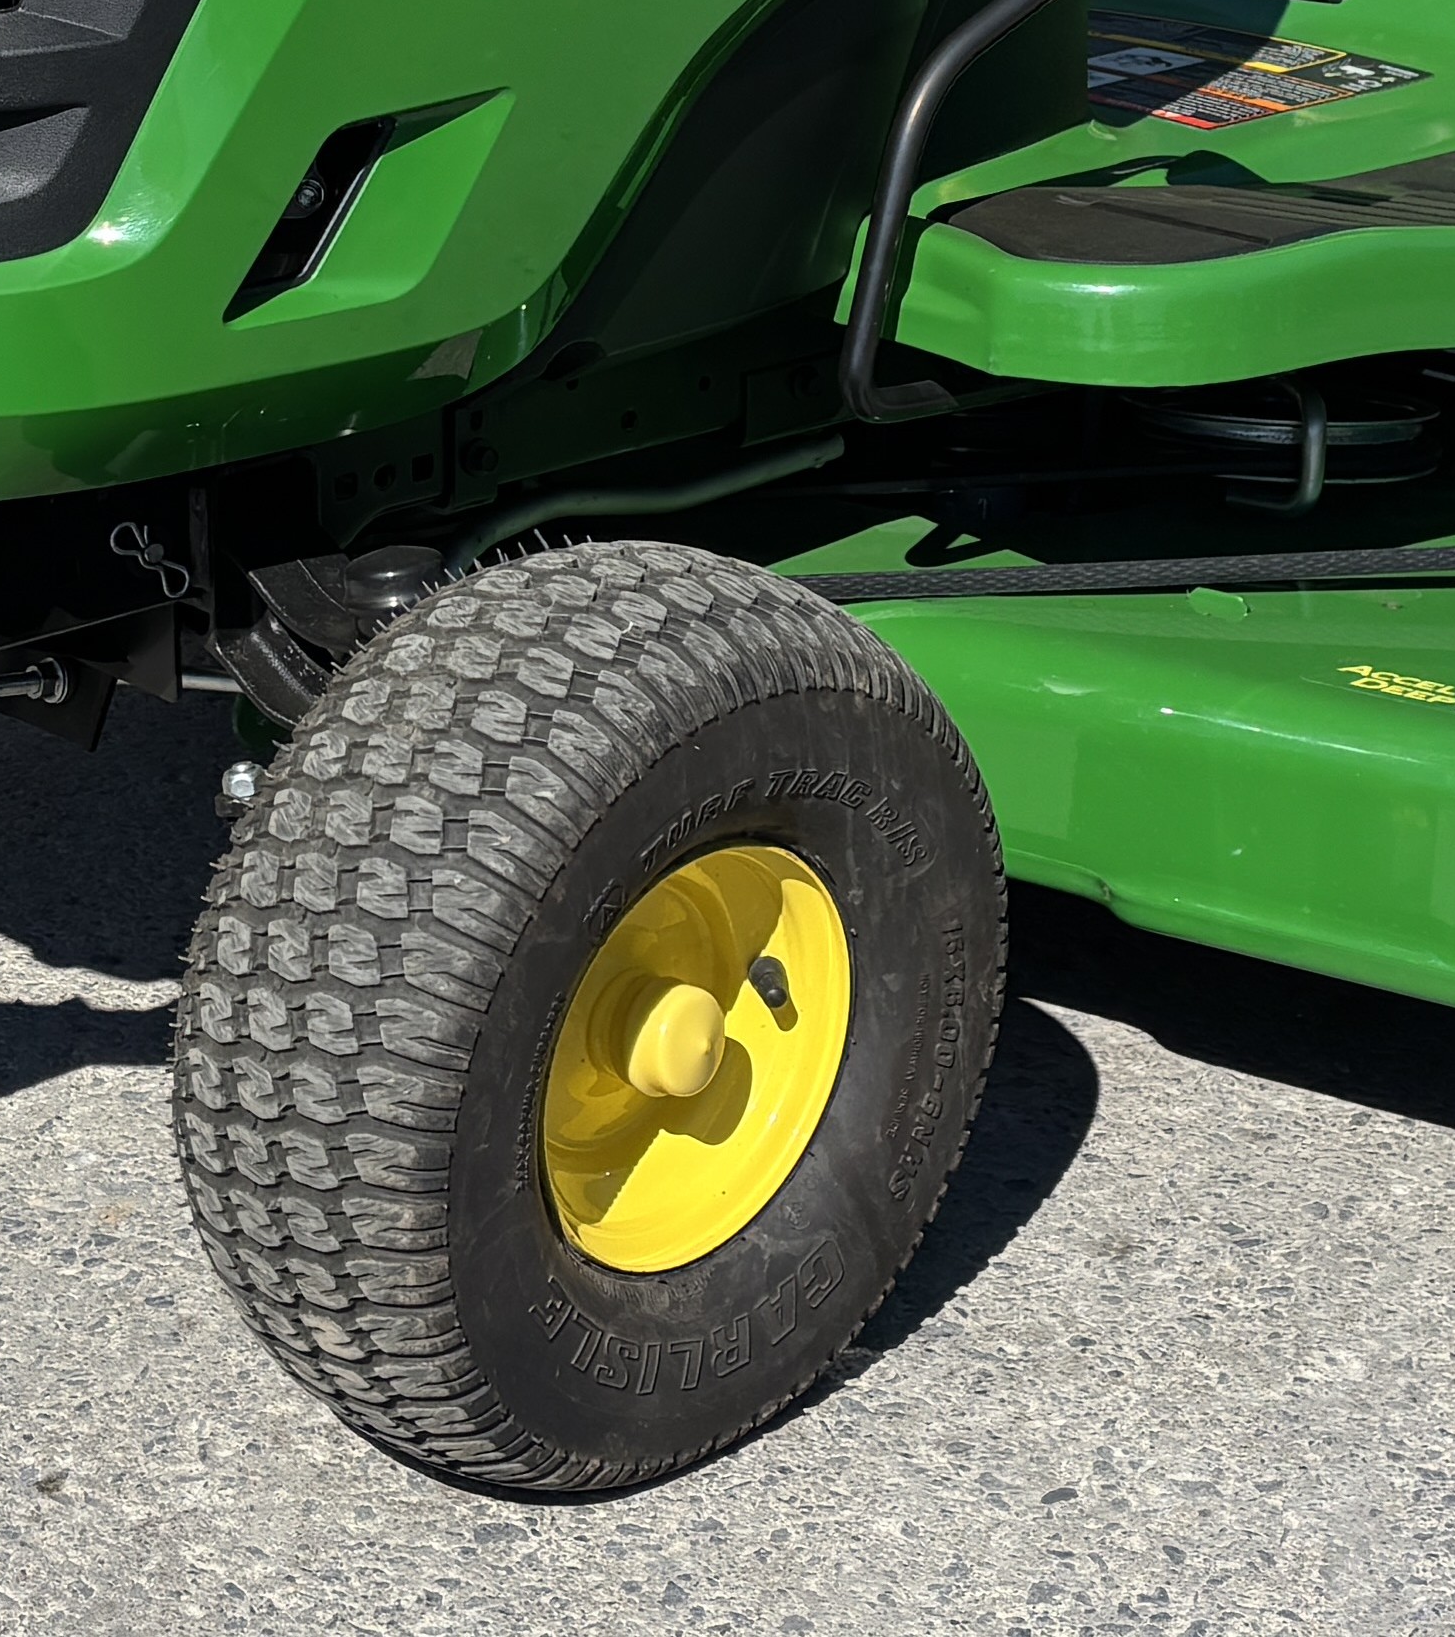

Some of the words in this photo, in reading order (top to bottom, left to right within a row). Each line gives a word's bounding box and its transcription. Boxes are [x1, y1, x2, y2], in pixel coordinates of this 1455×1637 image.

[640, 777, 755, 872] TURF
[764, 767, 873, 809] TRAC
[528, 1238, 845, 1395] CARLISLE
